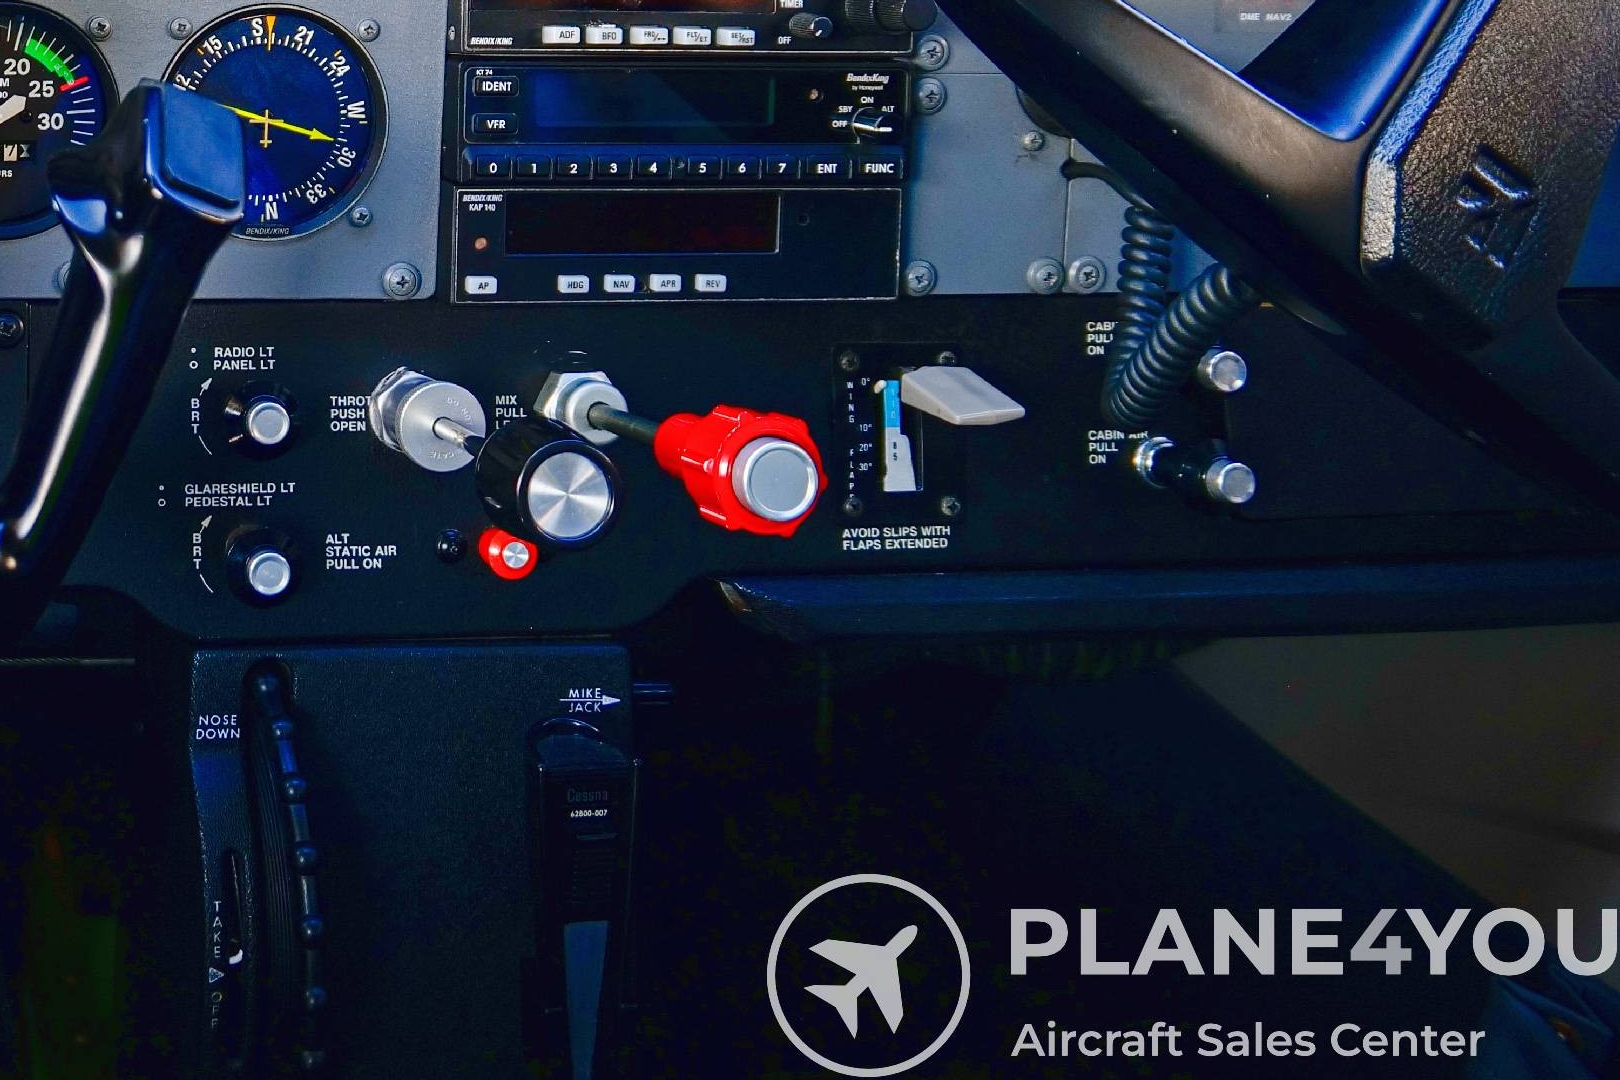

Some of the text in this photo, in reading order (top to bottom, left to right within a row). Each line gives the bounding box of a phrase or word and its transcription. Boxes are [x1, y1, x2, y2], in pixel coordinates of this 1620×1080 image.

[4, 59, 30, 75] 20
[482, 81, 511, 92] IDENT
[38, 113, 64, 129] 30
[487, 120, 505, 130] VFR
[817, 163, 837, 174] ENT
[865, 163, 894, 174] FUNC
[567, 280, 584, 289] HDG
[613, 279, 630, 288] NAV
[214, 347, 274, 357] RADIO LT
[214, 360, 275, 370] PANEL LT
[495, 396, 517, 405] MIX
[330, 408, 365, 419] PUSH
[495, 408, 527, 418] PULL
[330, 421, 366, 431] OPEN
[1088, 431, 1124, 440] CABIN
[185, 483, 295, 494] GLARESHIELD LT
[185, 495, 273, 507] PEDESTAL LT
[843, 526, 950, 538] AVOID SLIPS WITH
[326, 534, 349, 544] ALT
[843, 538, 948, 550] FLAPS EXTENDED
[326, 545, 397, 556] STATIC AIR
[326, 558, 381, 569] PULL ON
[568, 688, 601, 698] MIKE
[569, 703, 601, 713] JACK
[199, 715, 237, 726] NOSE
[196, 727, 240, 740] DOWN
